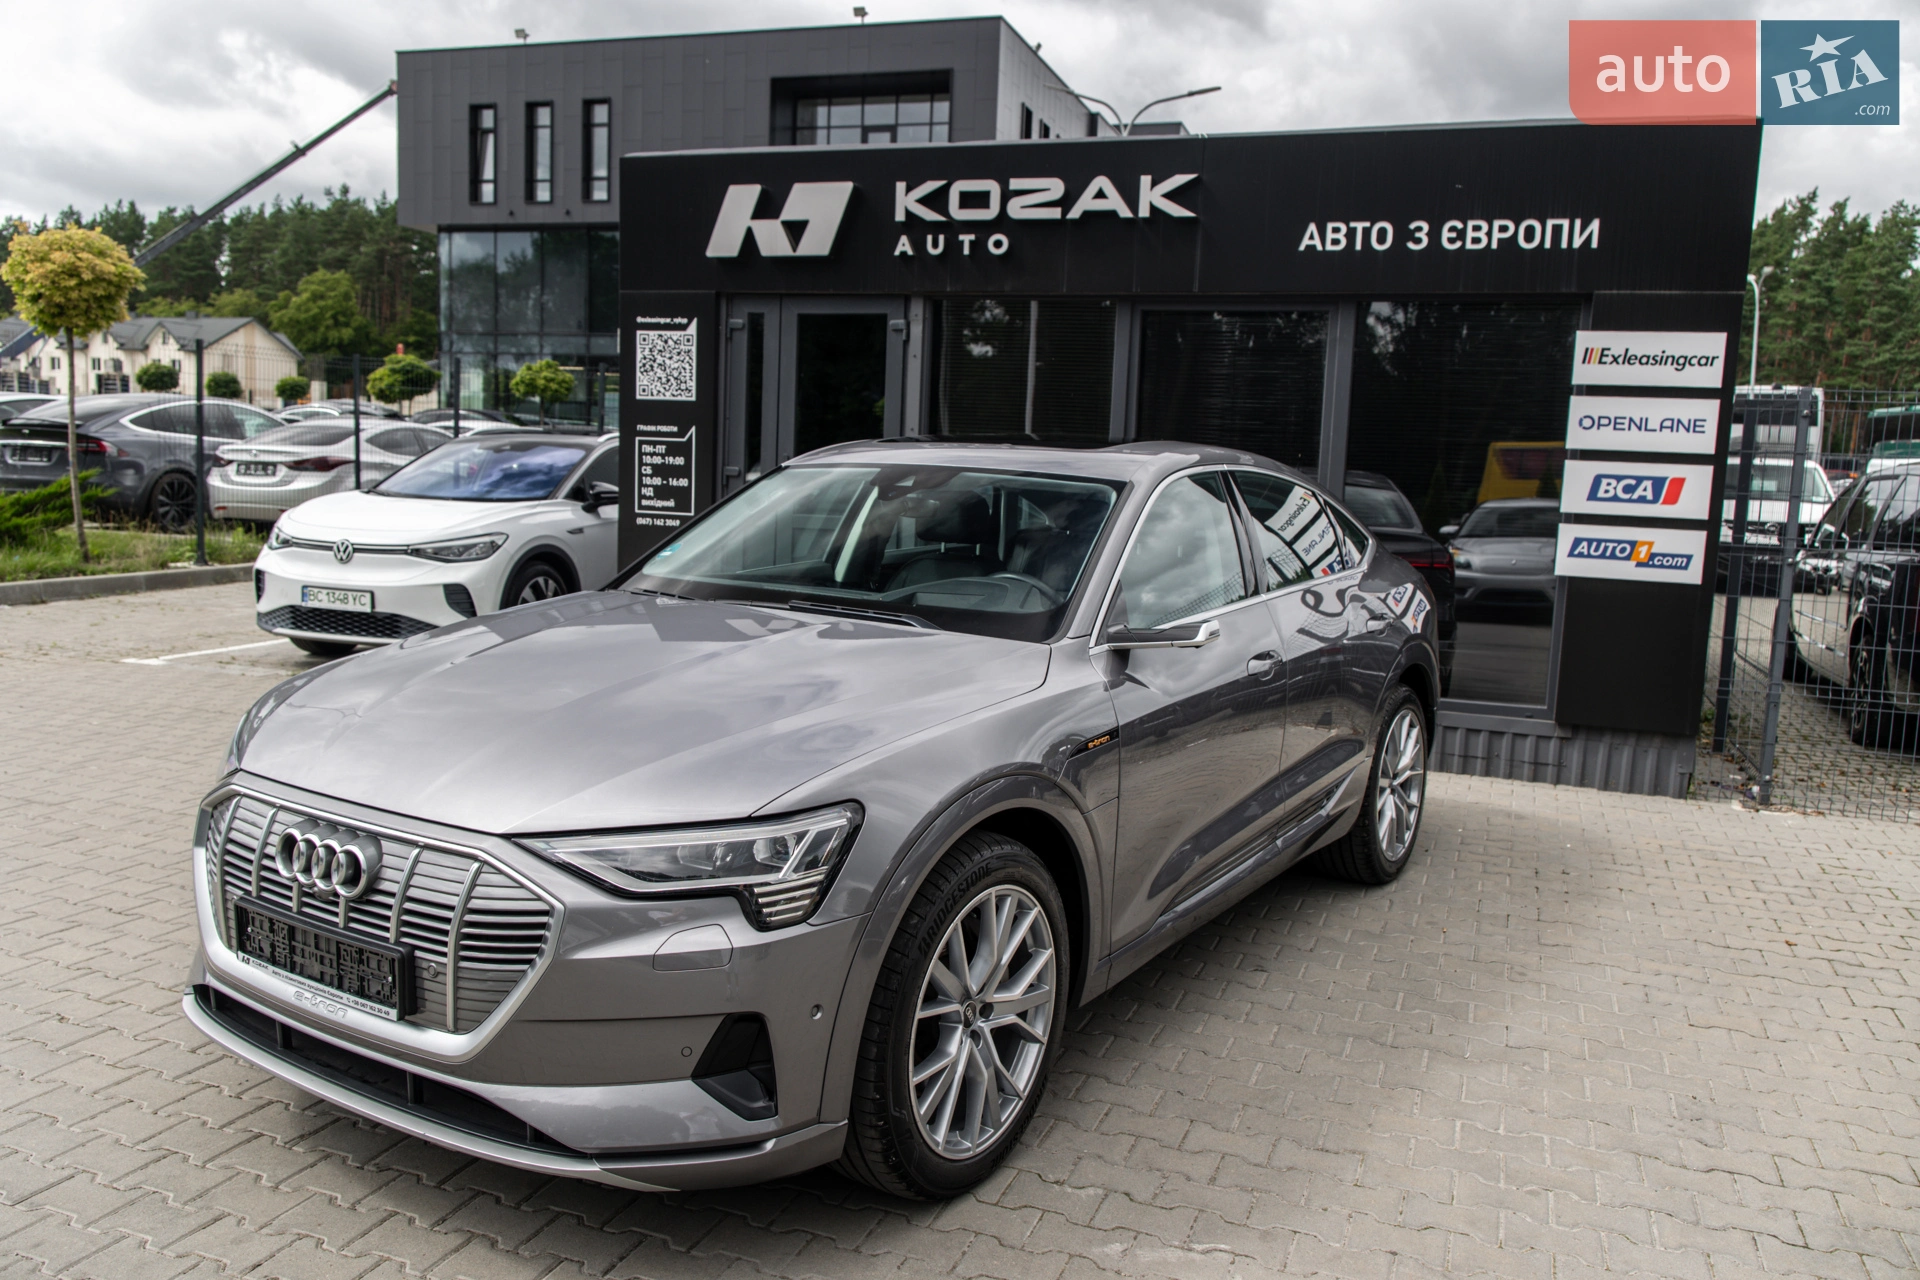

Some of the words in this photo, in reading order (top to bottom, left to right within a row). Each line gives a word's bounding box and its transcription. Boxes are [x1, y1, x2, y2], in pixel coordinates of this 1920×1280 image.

[895, 173, 1199, 221] KOZAK
[894, 232, 1010, 256] AUTO
[1298, 220, 1394, 251] АВТО
[1440, 217, 1600, 250] ЄВРОПИ
[1597, 347, 1719, 372] Exleasingcar
[1578, 414, 1707, 434] OPENLANE
[641, 444, 667, 454] ПН-ПТ
[641, 466, 653, 475] СБ
[642, 455, 685, 466] 10:00-19:00
[642, 476, 662, 486] 10:00
[668, 477, 689, 487] 16:00
[1596, 478, 1654, 501] BCA
[641, 487, 654, 497] НД
[653, 518, 664, 526] 162
[308, 589, 324, 603] BC
[326, 591, 349, 606] 1348
[918, 861, 993, 959] BRIDGESTONE
[292, 990, 349, 1019] e-tron
